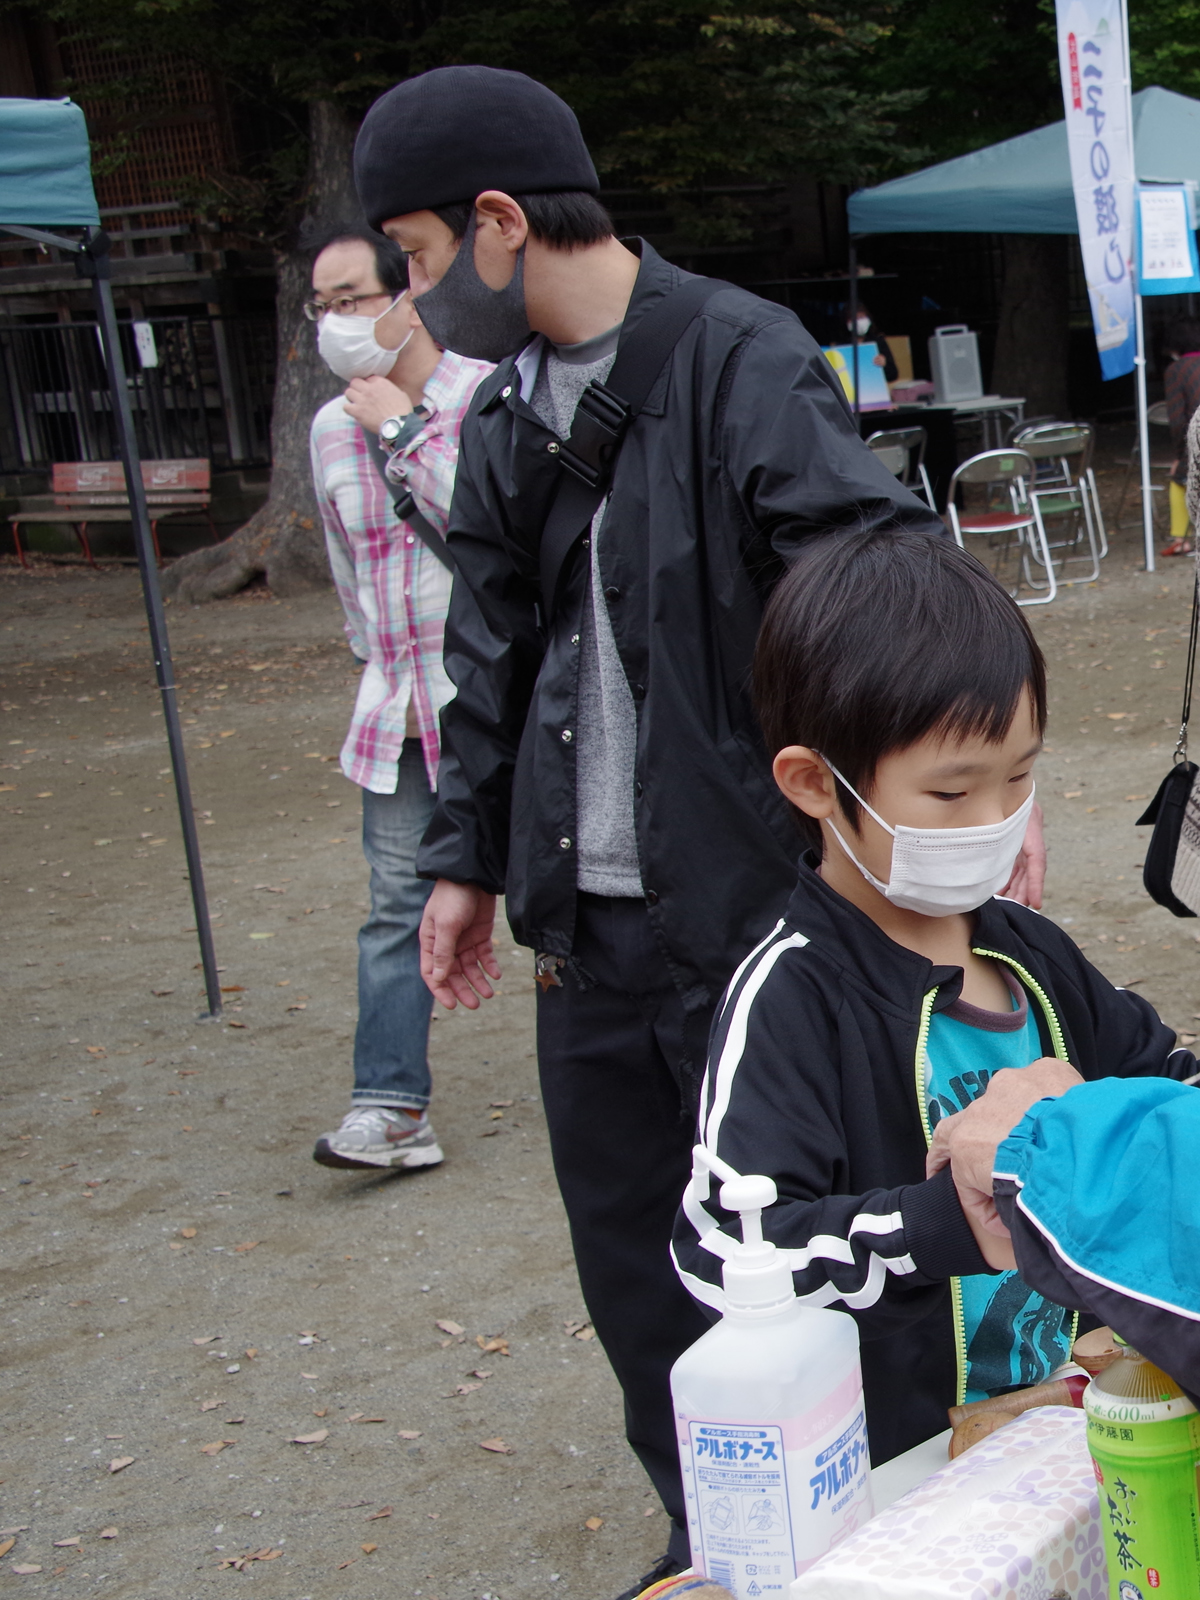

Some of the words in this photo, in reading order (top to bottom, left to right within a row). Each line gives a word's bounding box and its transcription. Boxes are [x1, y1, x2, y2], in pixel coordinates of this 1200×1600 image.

[1094, 1422, 1134, 1442] 伊藤園
[695, 1437, 778, 1461] アルボナース
